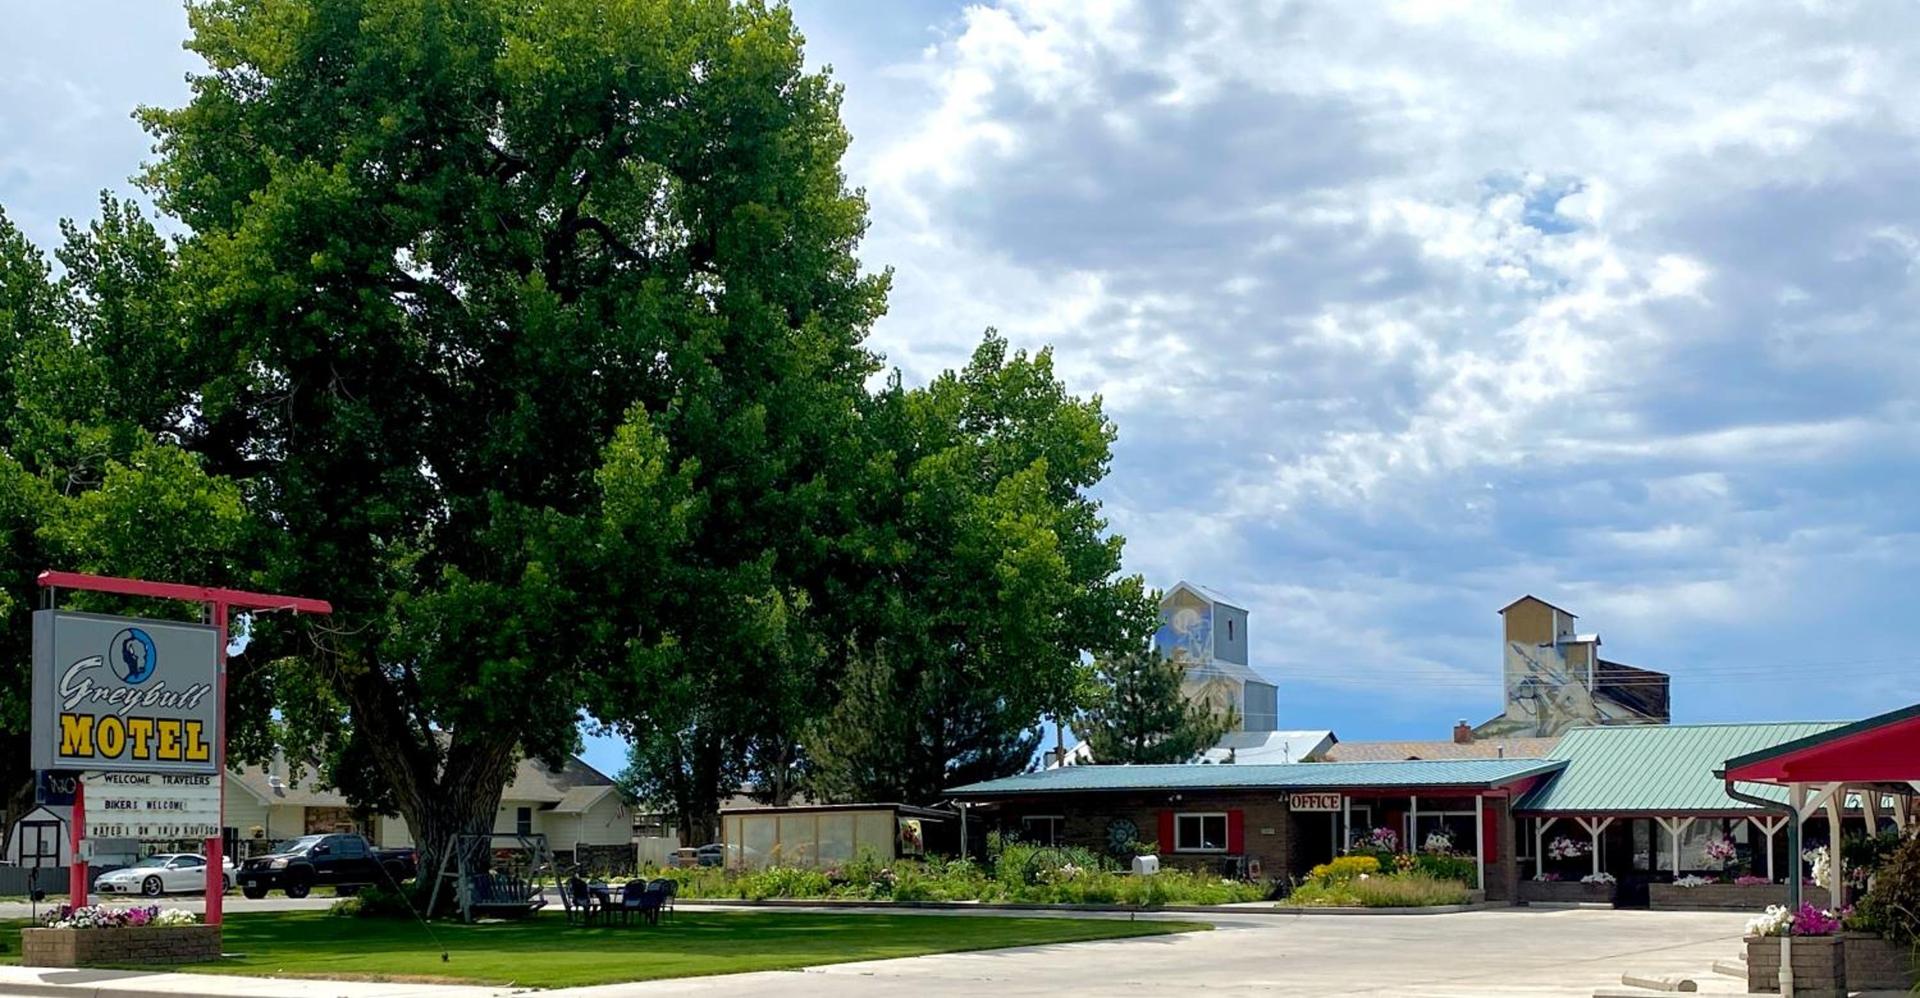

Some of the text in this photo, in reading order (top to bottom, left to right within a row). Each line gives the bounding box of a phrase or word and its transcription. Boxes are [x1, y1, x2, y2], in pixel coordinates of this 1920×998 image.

[58, 655, 211, 717] Greybull
[59, 713, 210, 762] MOTEL
[104, 774, 211, 786] WELCOME TRAVELERS
[104, 800, 138, 810] BIKERS
[1292, 795, 1339, 809] OFFICE
